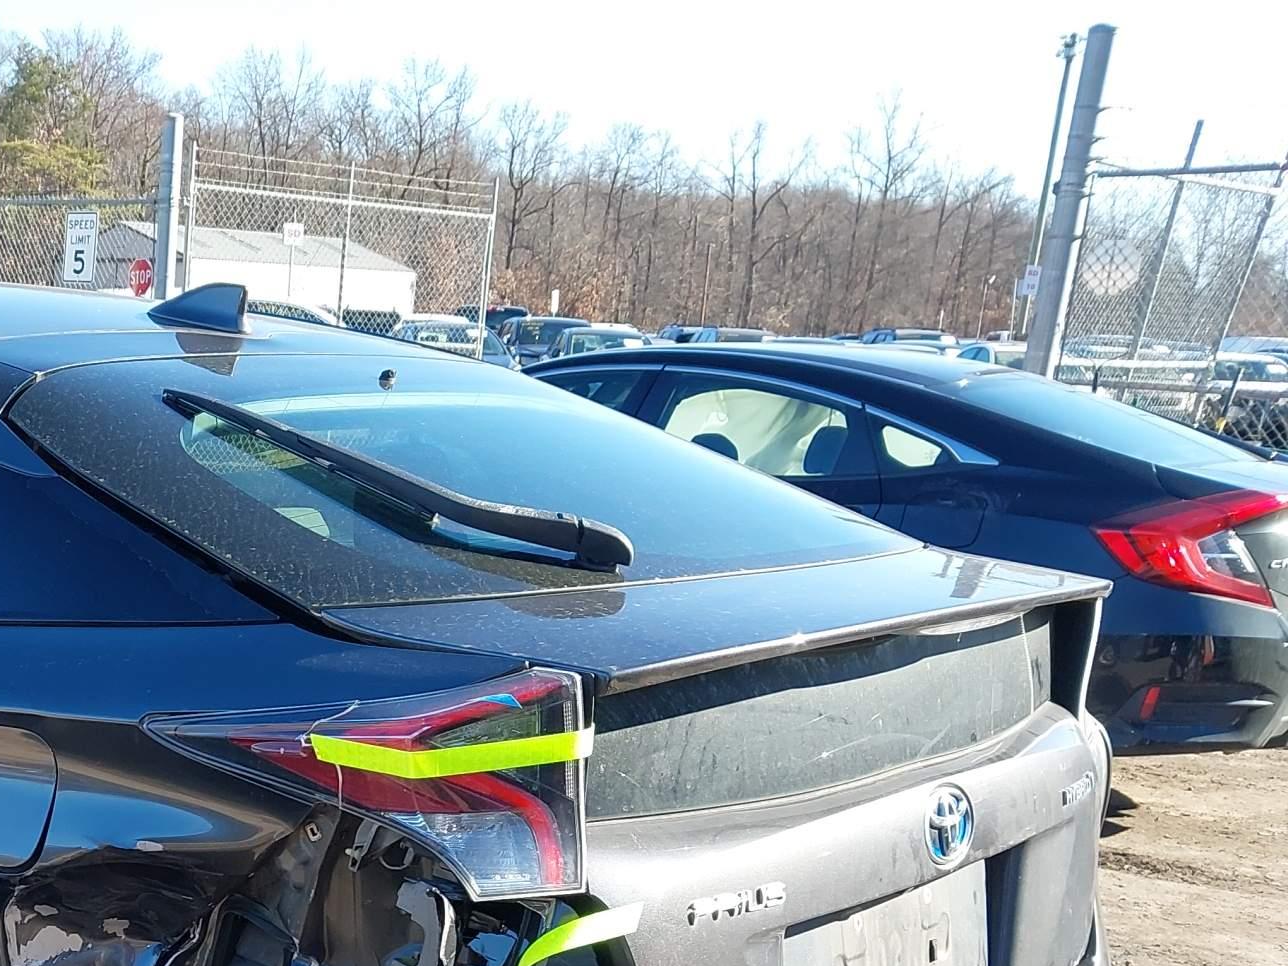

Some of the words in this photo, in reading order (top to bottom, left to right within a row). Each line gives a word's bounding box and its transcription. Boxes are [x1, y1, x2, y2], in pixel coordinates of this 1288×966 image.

[68, 220, 94, 230] SPEED
[70, 234, 91, 245] LIMIT
[73, 250, 84, 274] 5
[130, 270, 151, 284] STOP
[687, 881, 786, 926] PRIUS
